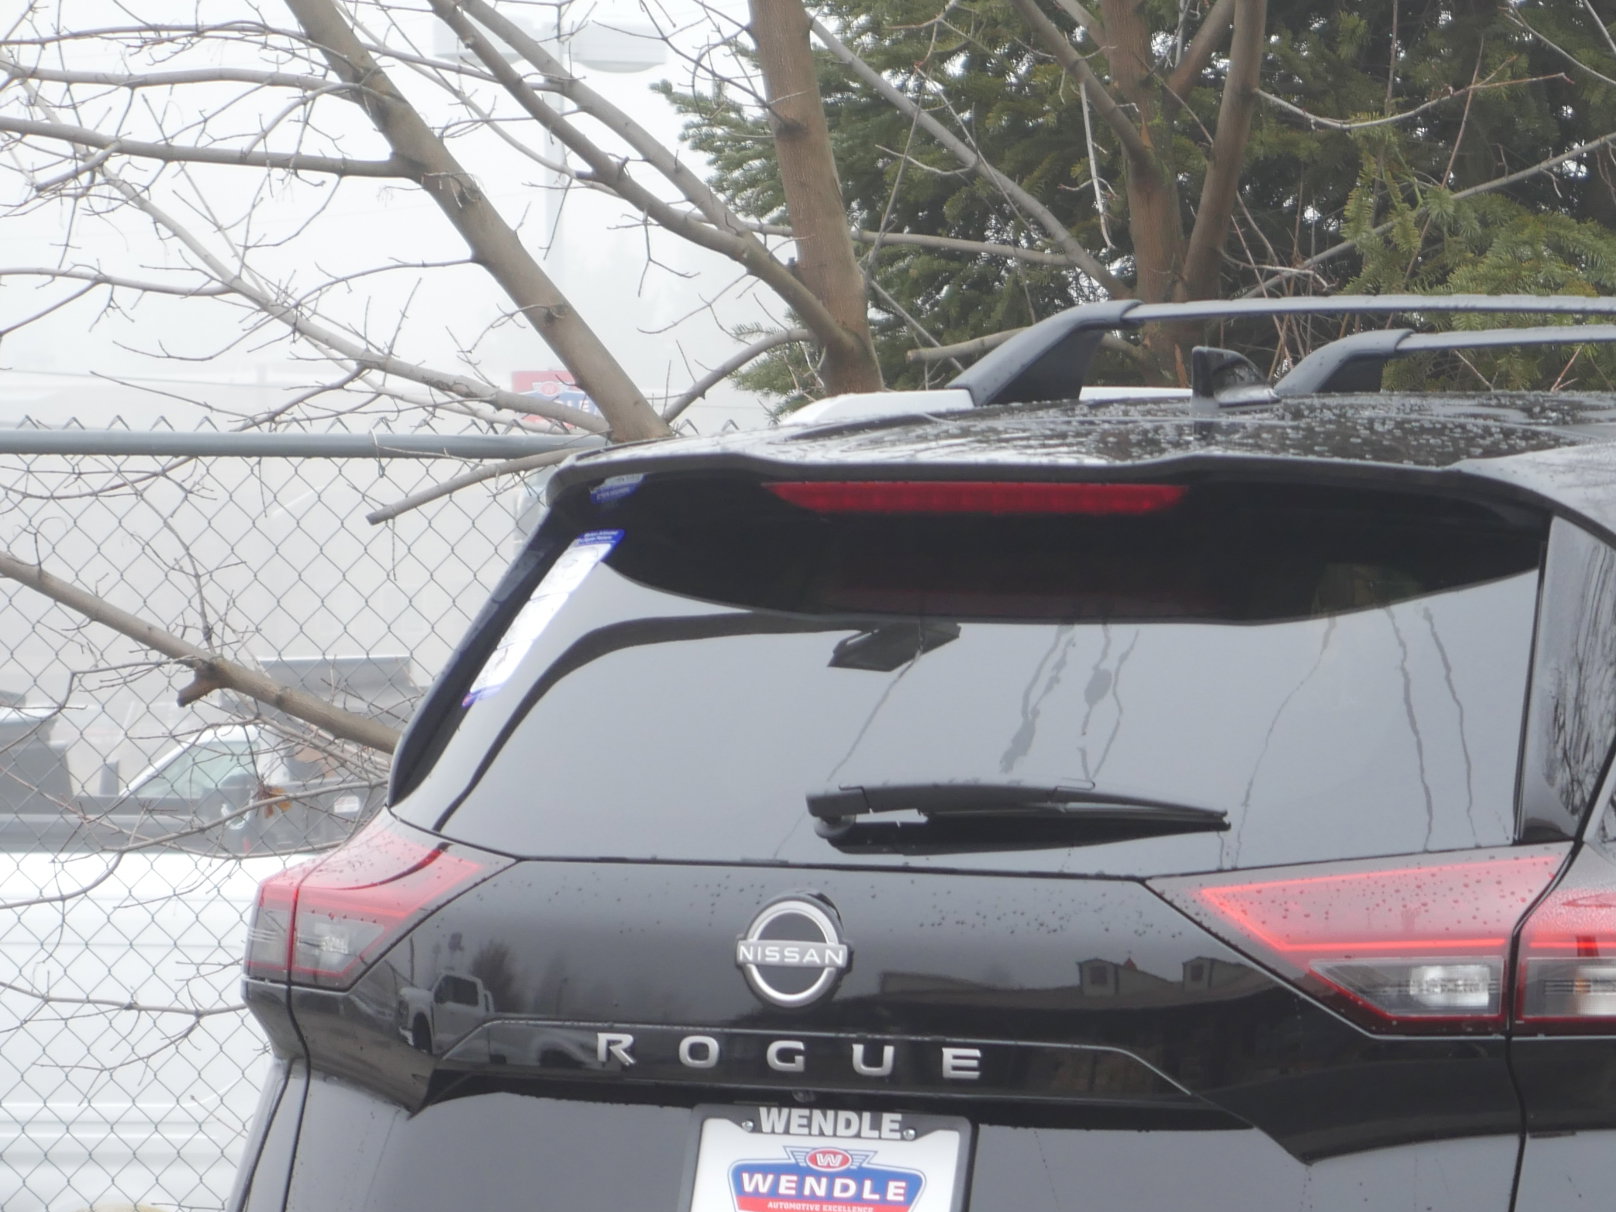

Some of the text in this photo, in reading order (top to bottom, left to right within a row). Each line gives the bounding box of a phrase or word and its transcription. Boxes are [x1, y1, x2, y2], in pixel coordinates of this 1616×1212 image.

[739, 944, 843, 965] NISSAN
[597, 1032, 982, 1080] ROGUE
[759, 1106, 902, 1141] WENDLE
[741, 1172, 907, 1202] WENDLE
[767, 1201, 820, 1211] AUTOMOTIVE
